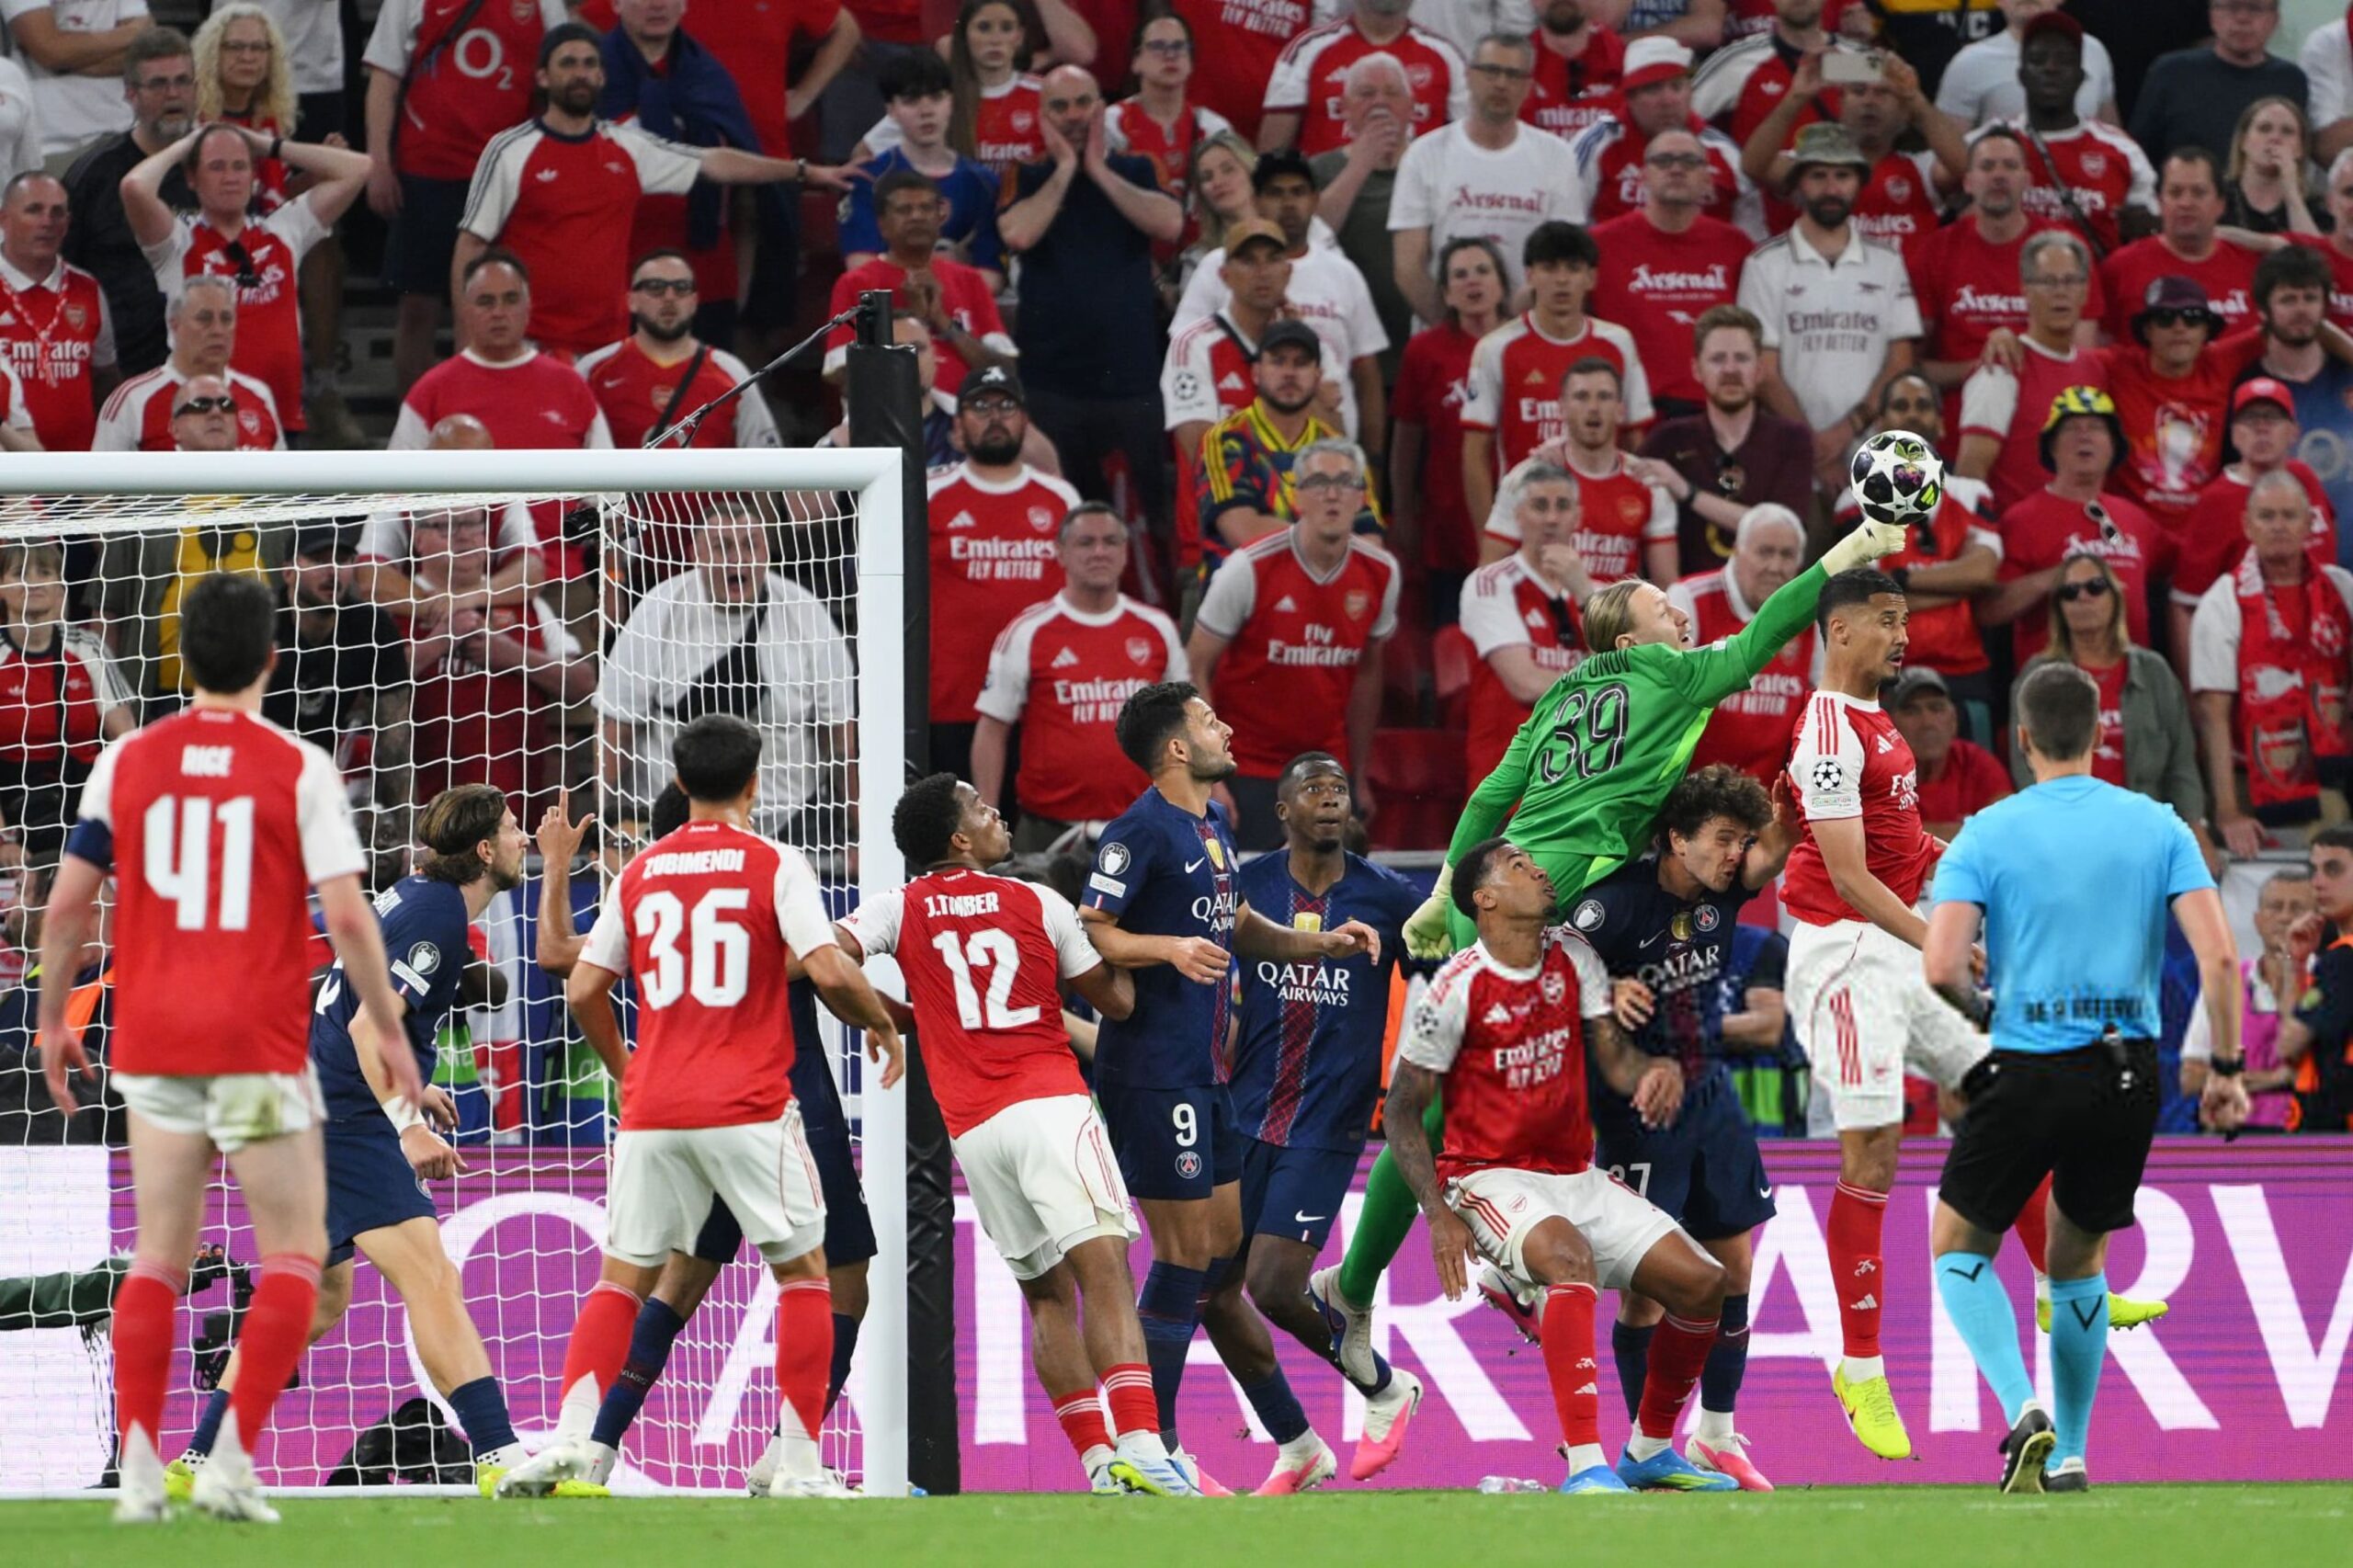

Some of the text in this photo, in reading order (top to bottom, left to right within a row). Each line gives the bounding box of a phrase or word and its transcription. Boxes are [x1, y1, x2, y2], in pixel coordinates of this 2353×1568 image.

[1450, 184, 1546, 213] Arsenal
[1628, 264, 1727, 292] Arsenal
[1788, 307, 1879, 334] Emirates
[949, 536, 1057, 559] Emirates
[968, 560, 1043, 580] FLY BETTER
[1304, 623, 1335, 644] Fly
[1267, 639, 1361, 665] Emirates
[1054, 676, 1150, 706] Emirate
[1074, 704, 1097, 723] FLY
[1741, 696, 1788, 716] BETTER
[1540, 682, 1630, 784] 39
[181, 744, 234, 778] RICE
[144, 792, 256, 931] 41
[642, 848, 745, 880] ZUBIMENDI
[924, 891, 1000, 918] J.TIMBER
[632, 888, 751, 1011] 36
[932, 927, 1041, 1030] 12
[1256, 960, 1351, 992] QATAR
[1637, 944, 1721, 988] QATAR
[1277, 984, 1349, 1007] AIRWAYS
[1172, 1103, 1198, 1147] 9
